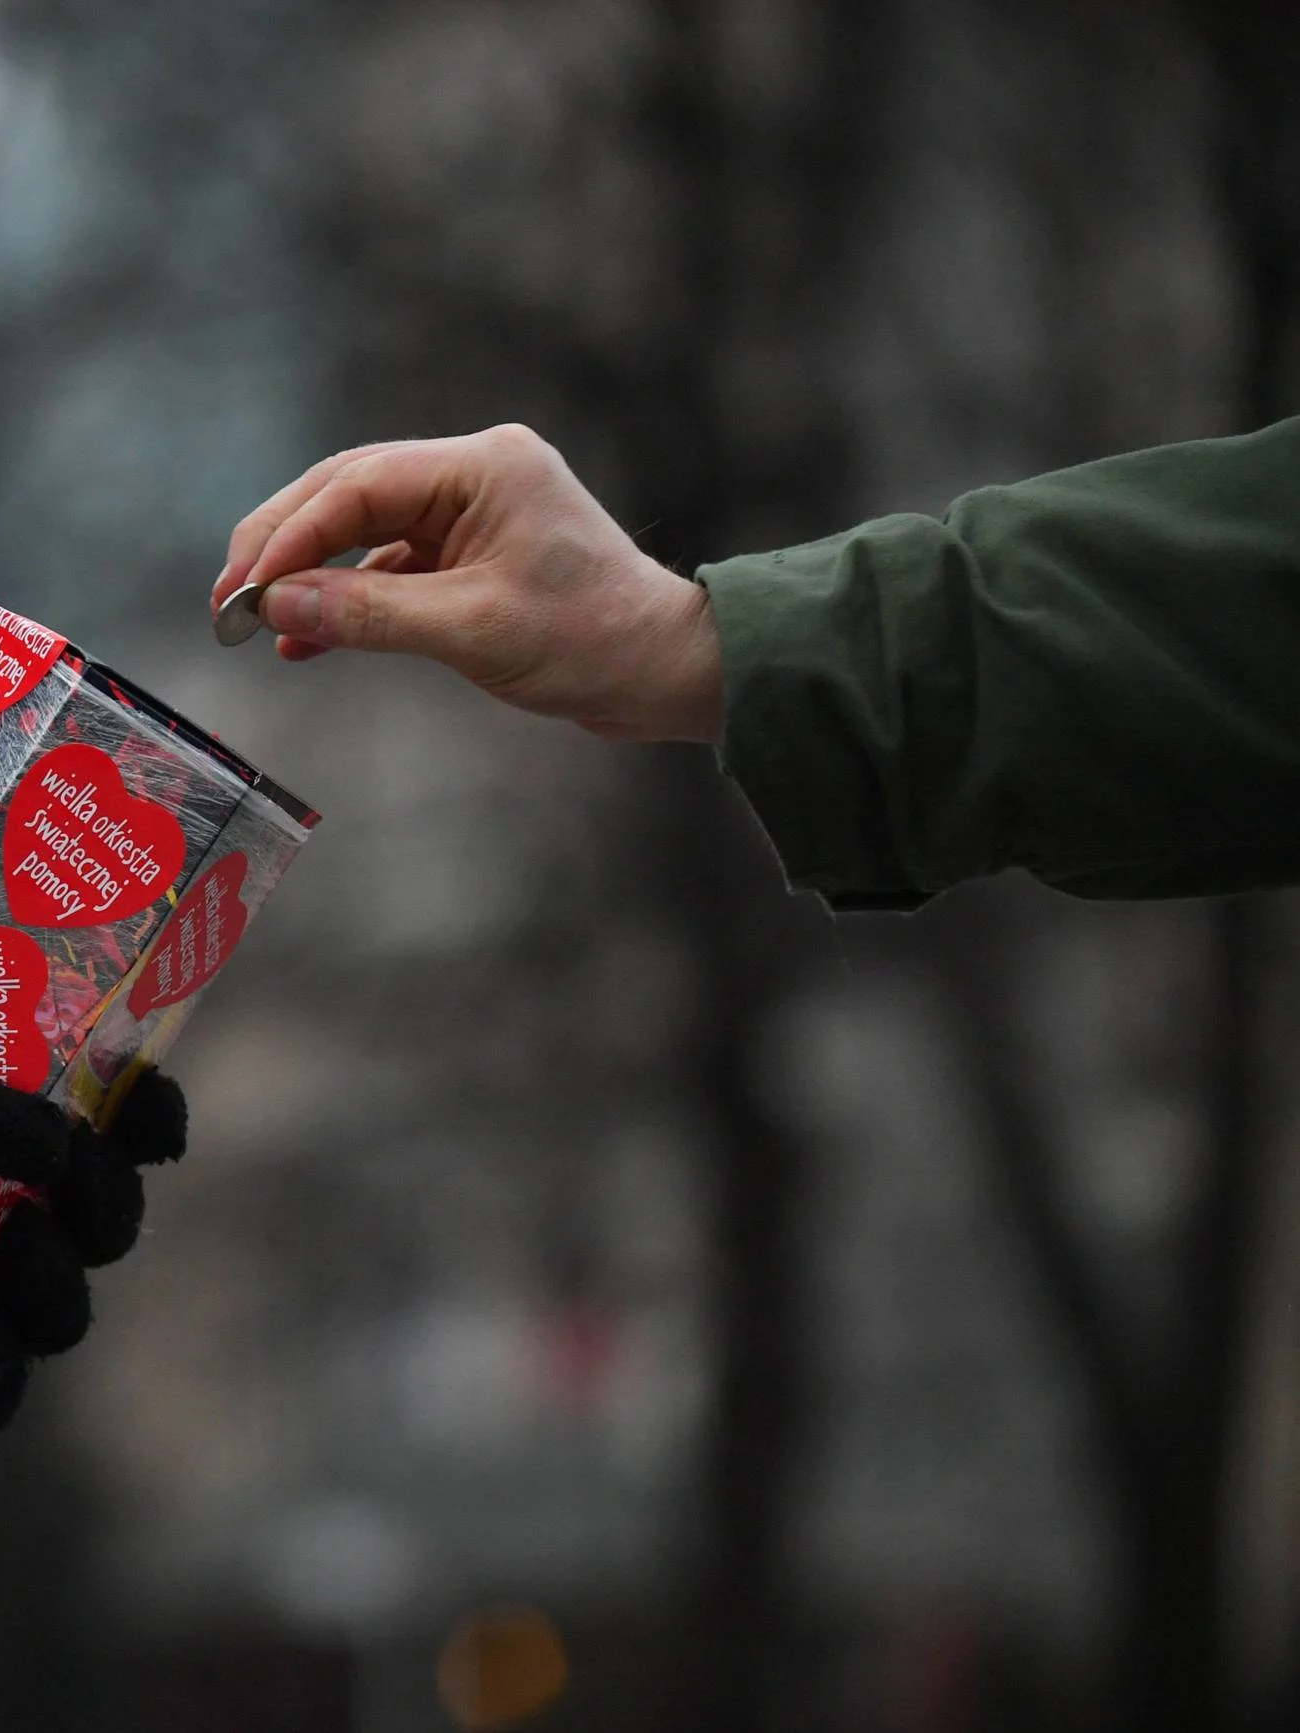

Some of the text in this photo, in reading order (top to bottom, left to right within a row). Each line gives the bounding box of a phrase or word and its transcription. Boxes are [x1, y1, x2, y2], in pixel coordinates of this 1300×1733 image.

[24, 803, 130, 911] świątecznej
[40, 768, 161, 886] wielka orkiestra
[12, 851, 86, 921] pomocy
[205, 872, 229, 917] wielka
